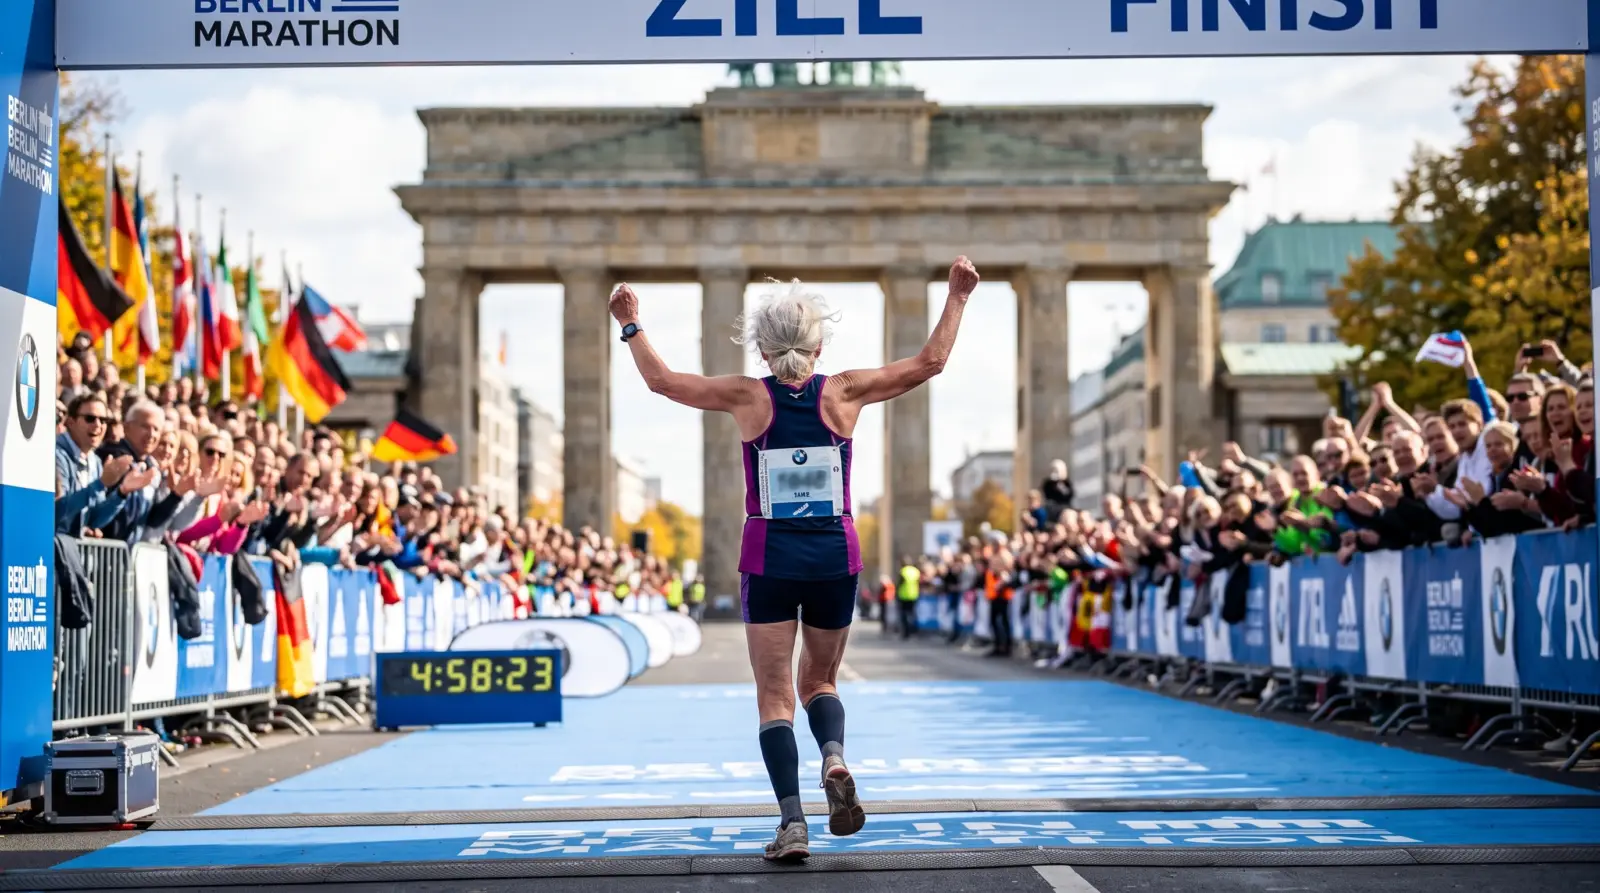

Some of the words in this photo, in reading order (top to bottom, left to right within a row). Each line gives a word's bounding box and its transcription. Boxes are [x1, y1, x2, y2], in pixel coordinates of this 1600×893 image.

[194, 19, 400, 47] MARATHON
[8, 94, 38, 134] BERLIN
[8, 124, 38, 160] BERLIN
[8, 152, 52, 195] MARATHON
[8, 566, 34, 594] BERLIN
[8, 598, 34, 622] BERLIN
[8, 626, 47, 652] MARATHON
[411, 656, 553, 693] 4:58:23
